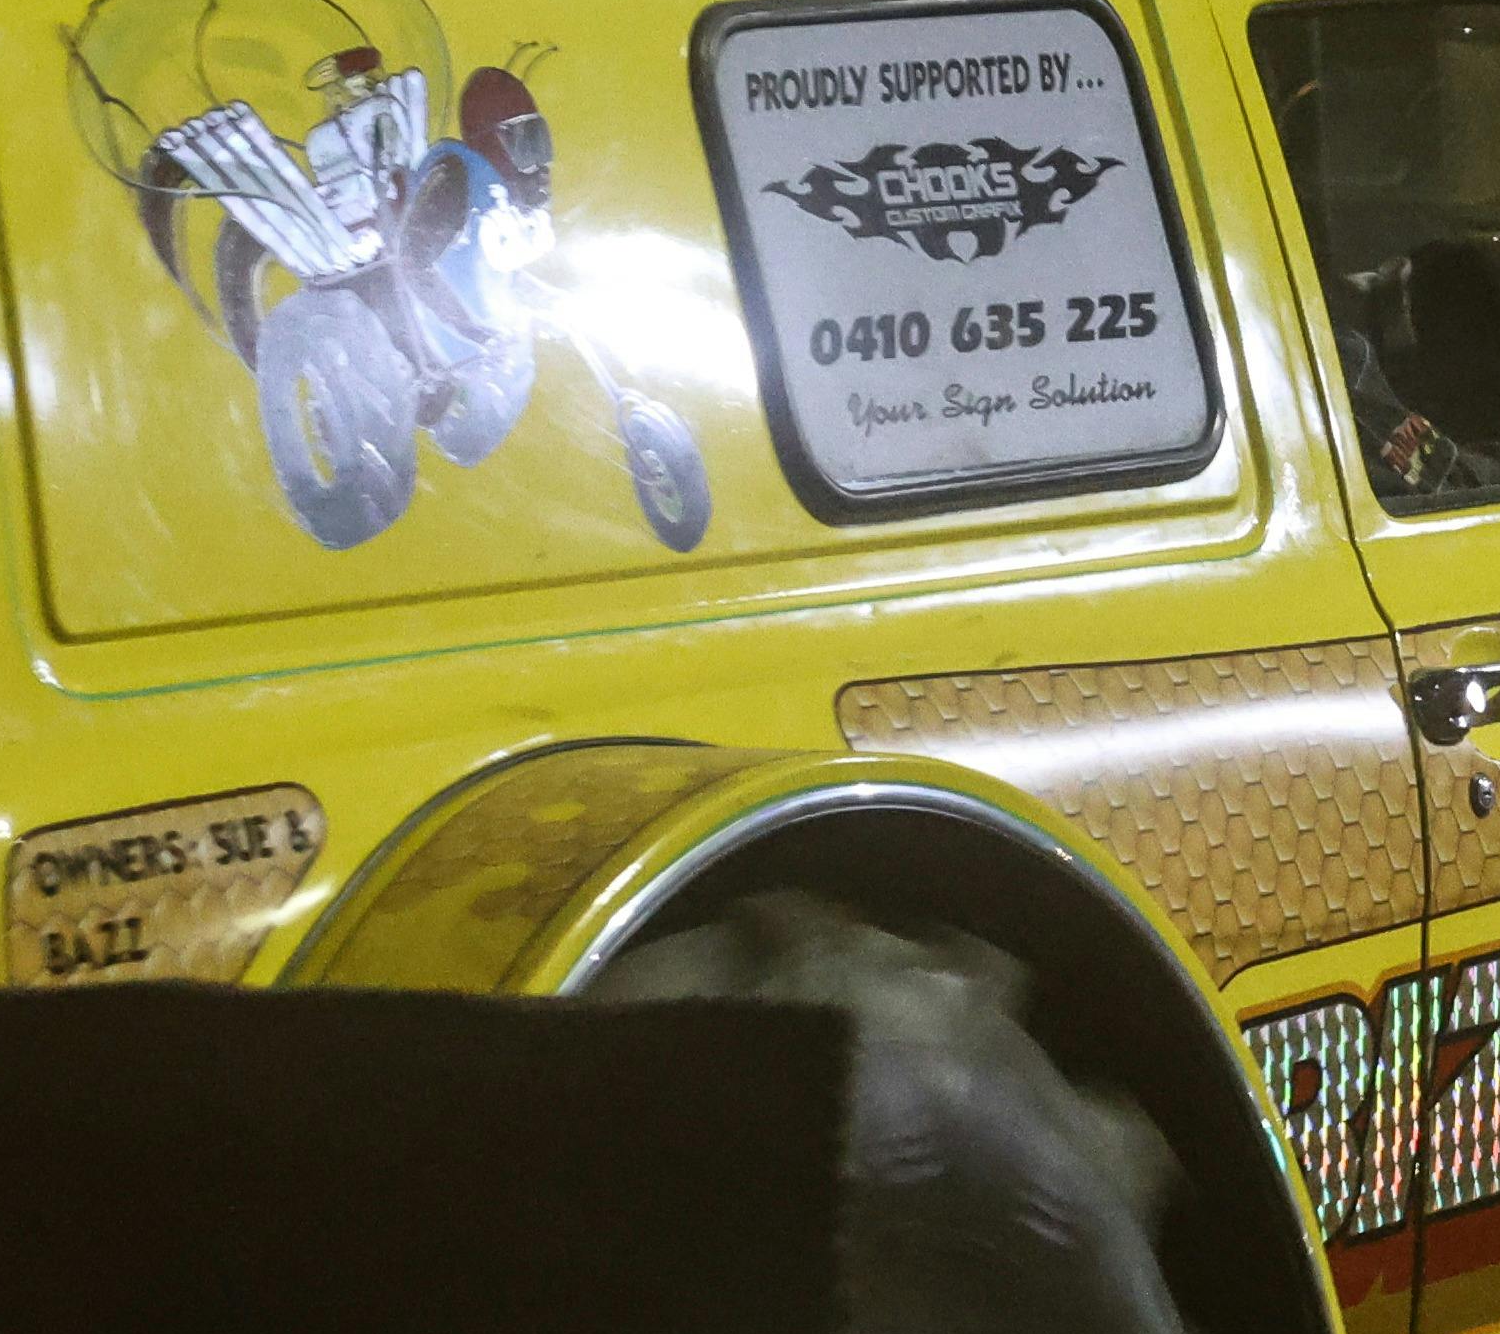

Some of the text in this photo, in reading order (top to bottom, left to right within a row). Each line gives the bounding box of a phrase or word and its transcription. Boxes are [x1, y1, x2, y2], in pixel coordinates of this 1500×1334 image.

[745, 64, 868, 112] PROUDLY
[879, 54, 1030, 104] SUPPORTED
[876, 161, 1019, 205] CHOOKS
[809, 292, 1157, 366] 0410 635 225
[847, 371, 1156, 439] Your Sign Solution
[208, 814, 274, 866] SUE
